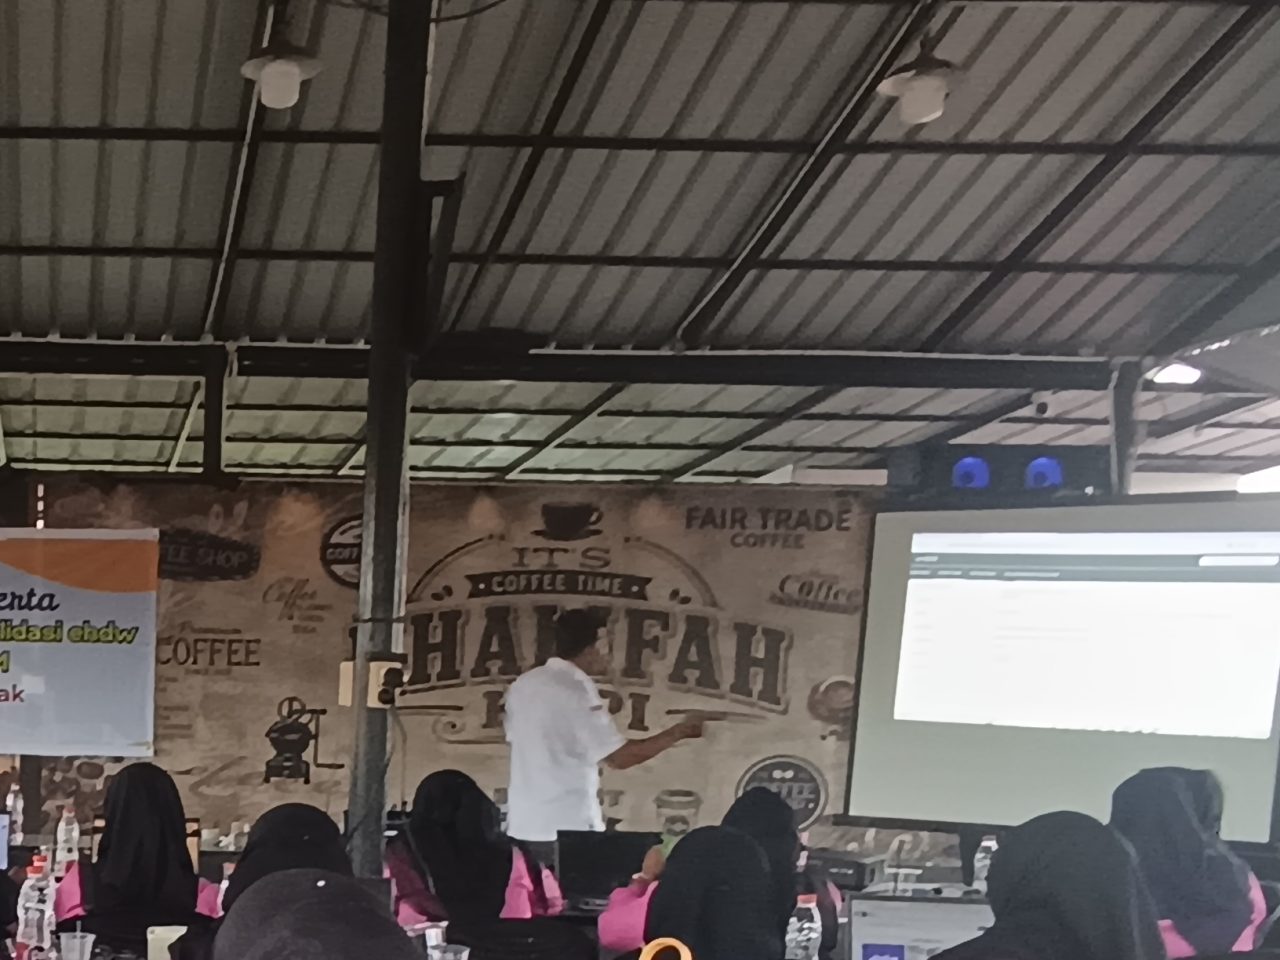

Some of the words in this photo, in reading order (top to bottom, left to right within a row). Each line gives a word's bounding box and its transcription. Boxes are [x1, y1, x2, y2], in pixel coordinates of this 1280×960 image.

[684, 506, 748, 530] FAIR
[757, 507, 852, 532] TRADE
[730, 532, 805, 549] COFFEE
[197, 546, 249, 568] SHOP
[510, 546, 612, 569] IT'S
[491, 574, 566, 593] COFFEE
[577, 575, 623, 595] TIME
